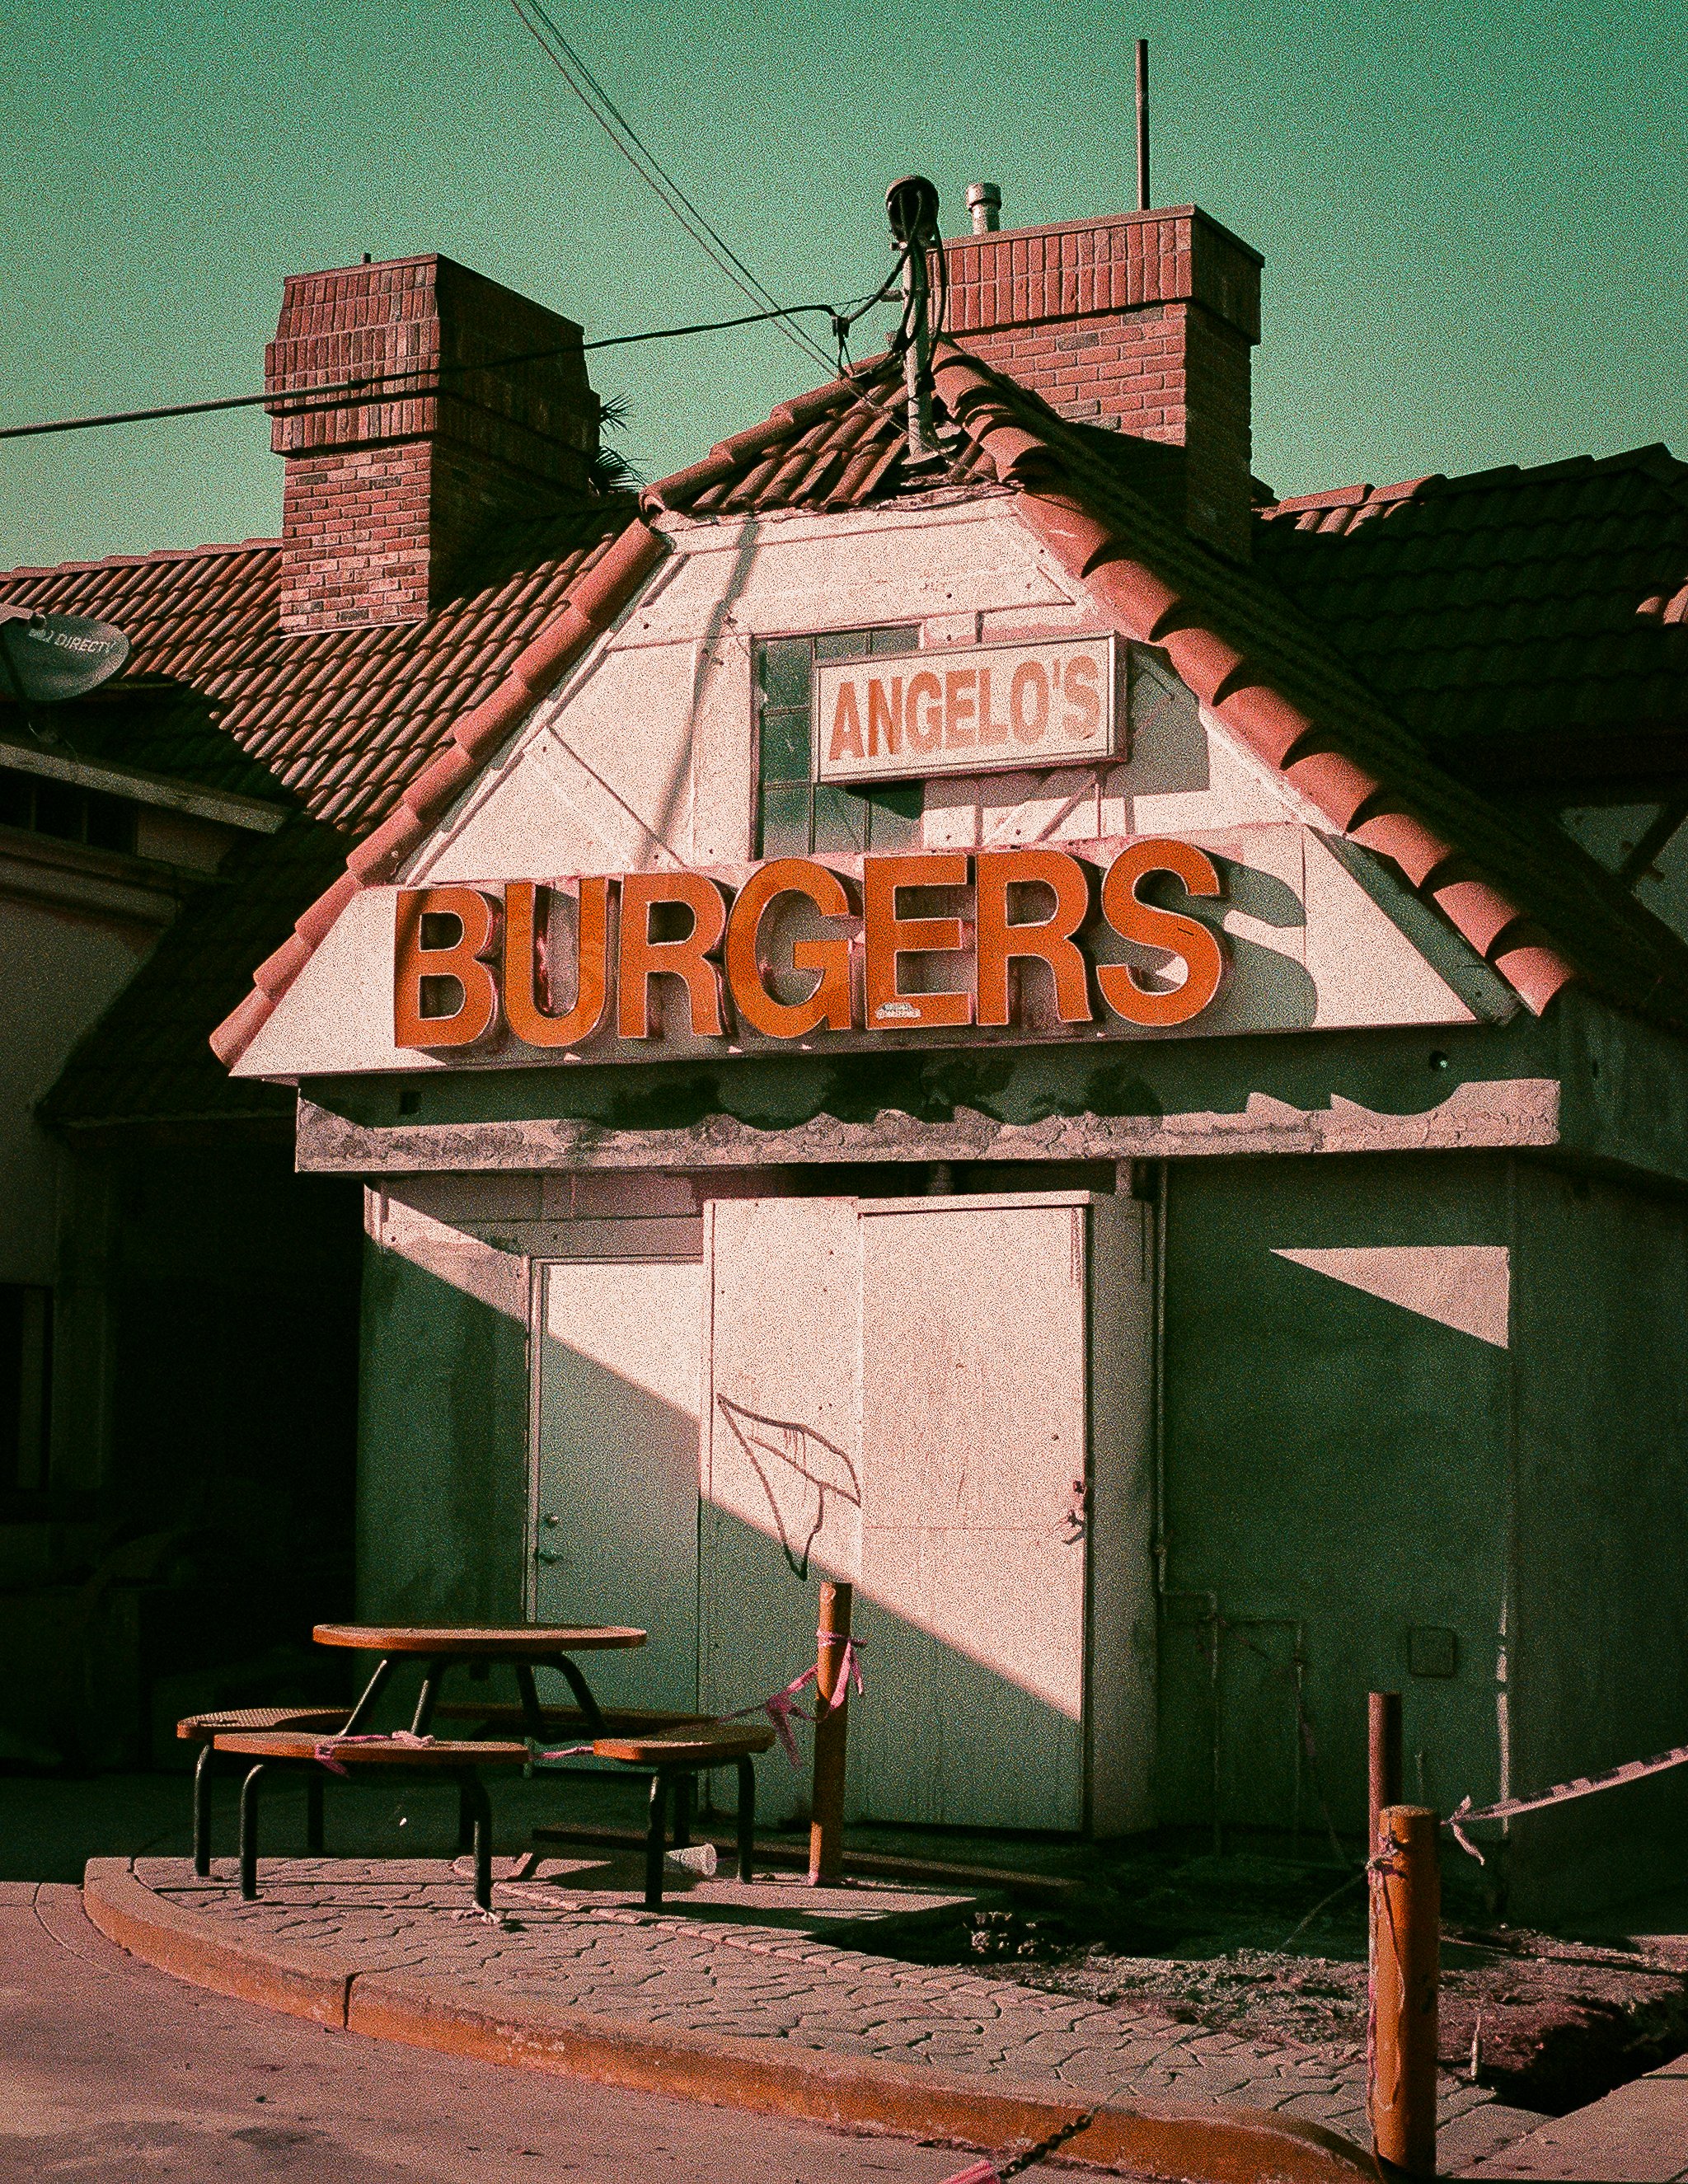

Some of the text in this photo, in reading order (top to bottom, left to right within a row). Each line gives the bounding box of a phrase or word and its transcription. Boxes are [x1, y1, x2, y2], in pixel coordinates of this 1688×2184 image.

[54, 632, 116, 654] DIRECTV
[828, 655, 1101, 760] ANGELO'S
[394, 838, 1222, 1048] BURGERS
